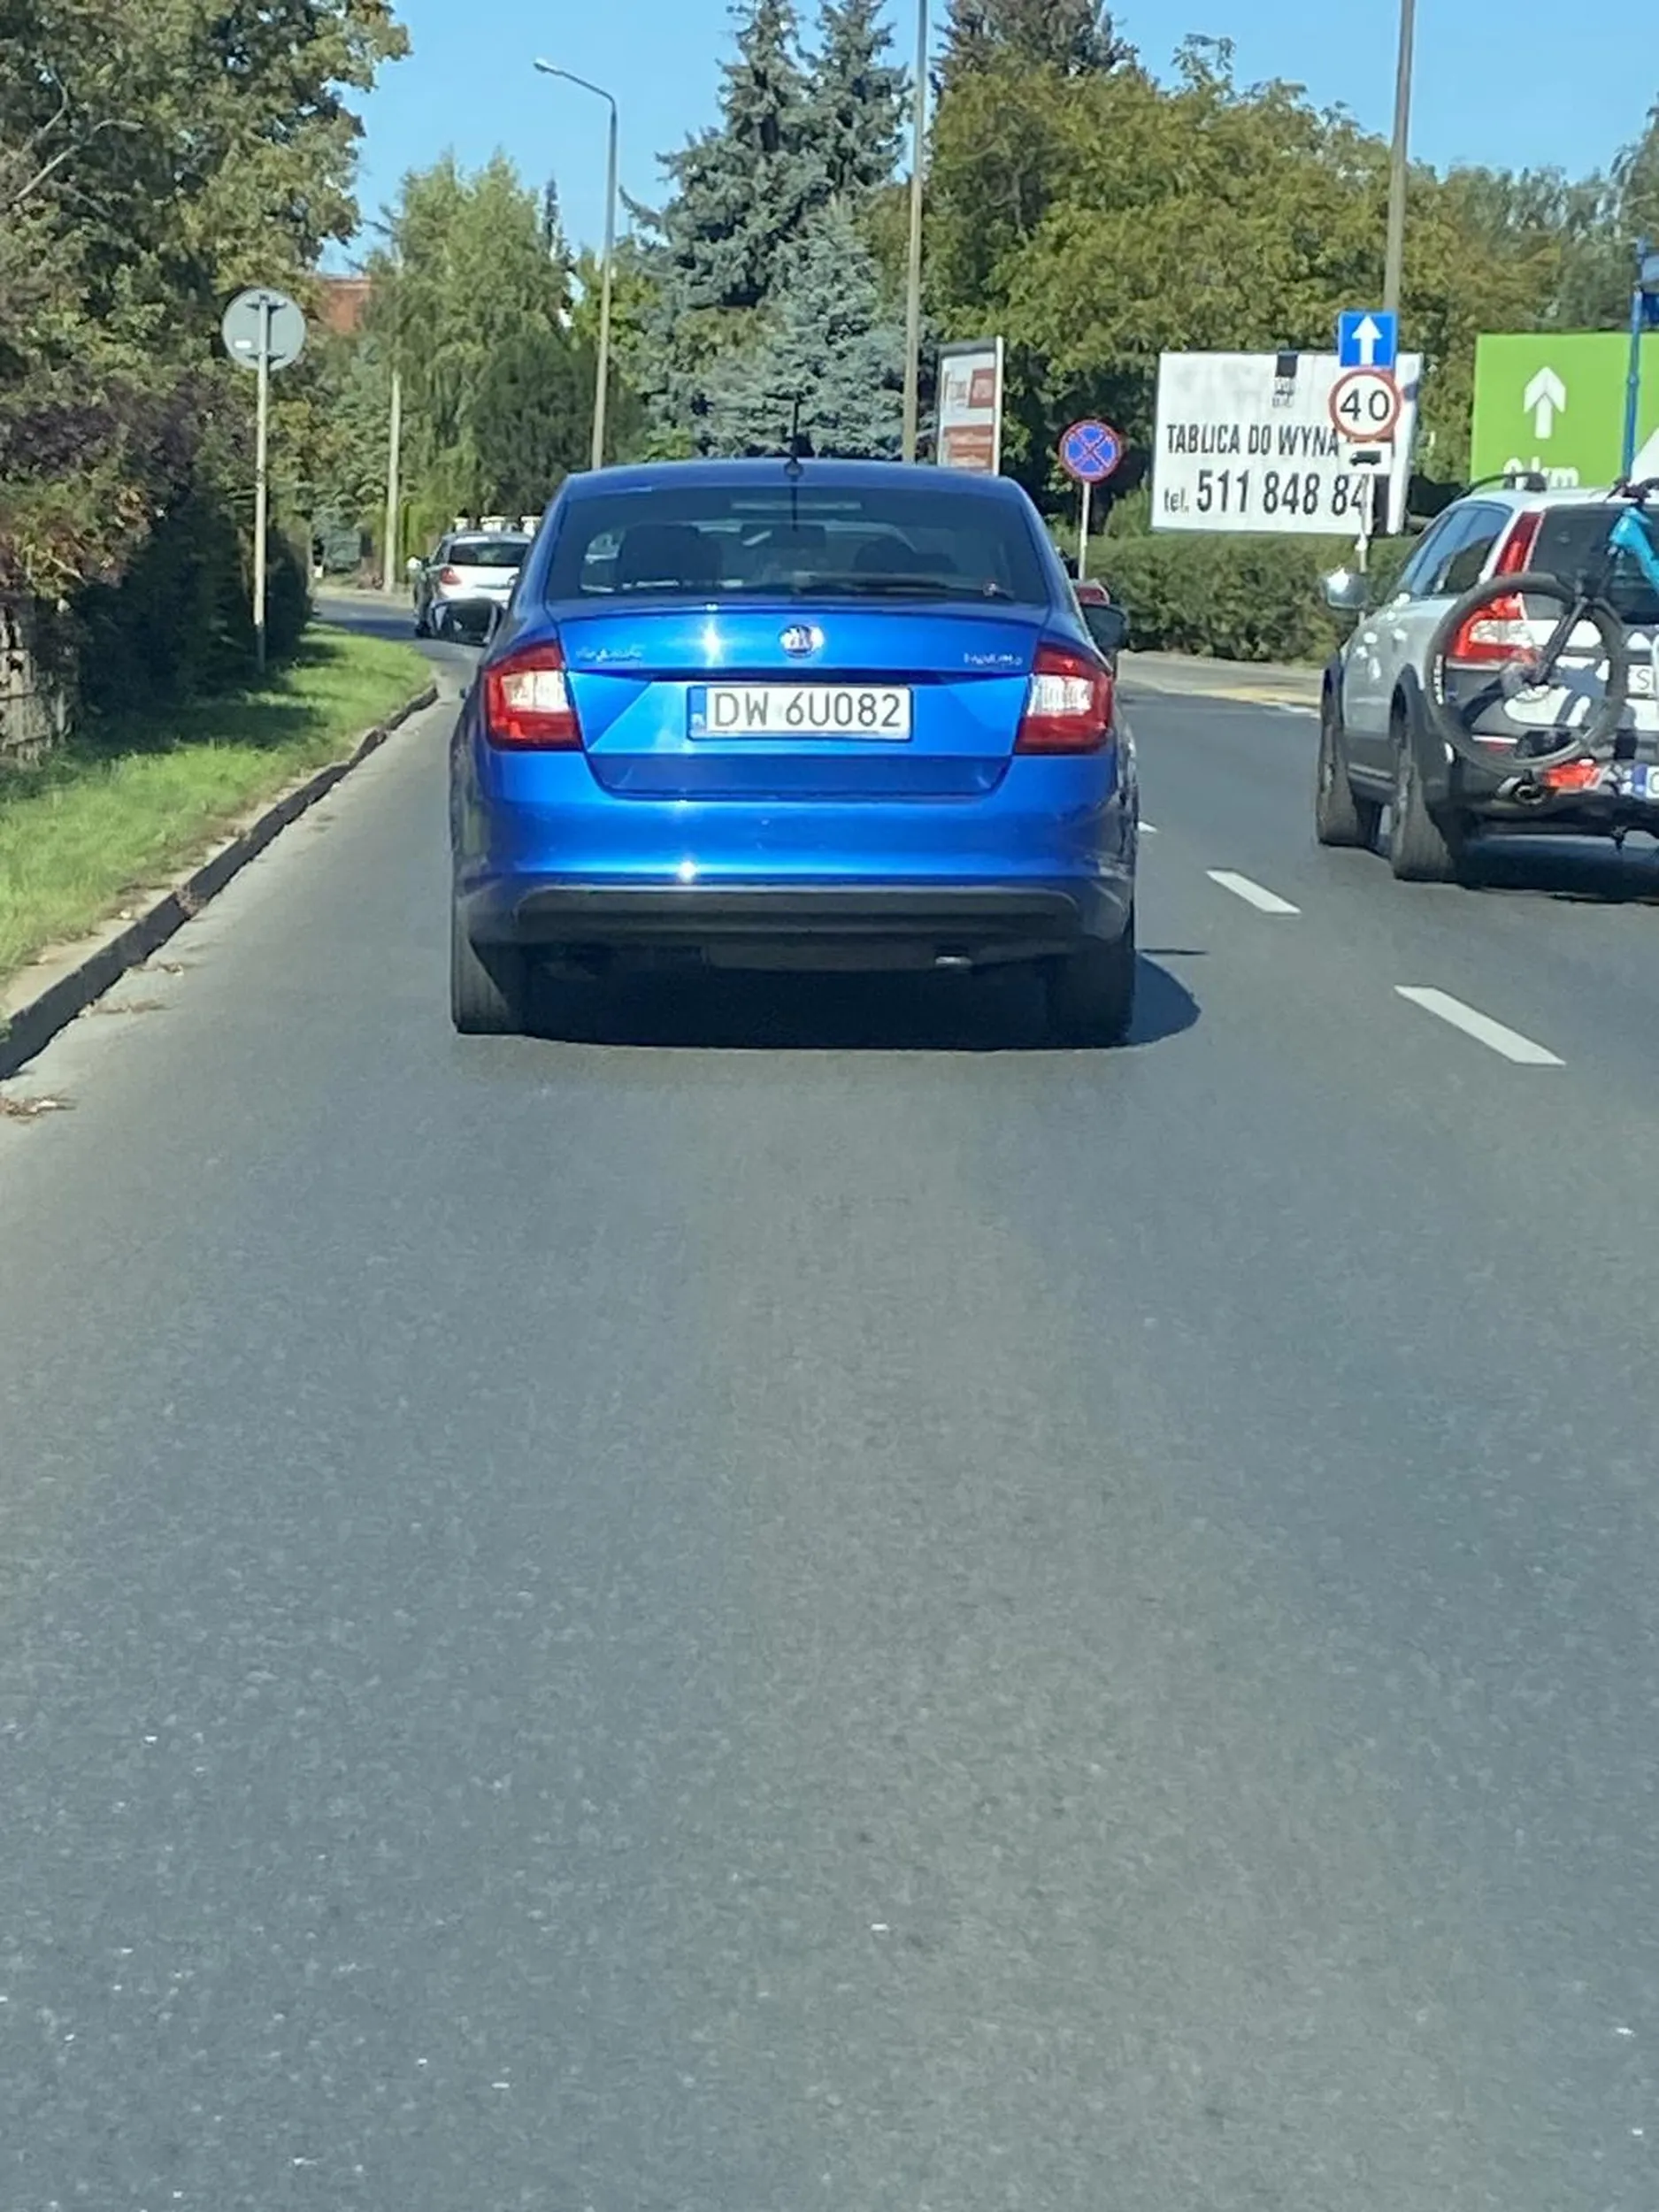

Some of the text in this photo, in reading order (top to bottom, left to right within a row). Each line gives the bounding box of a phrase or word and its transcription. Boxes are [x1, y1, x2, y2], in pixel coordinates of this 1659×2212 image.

[1340, 388, 1390, 422] 40
[1166, 423, 1240, 454] TABLICA
[1248, 423, 1271, 456] DO
[1164, 487, 1190, 513] tel.
[1196, 468, 1250, 513] 511
[1263, 471, 1321, 516] 848
[714, 691, 769, 727] DW
[786, 691, 901, 727] 6U082
